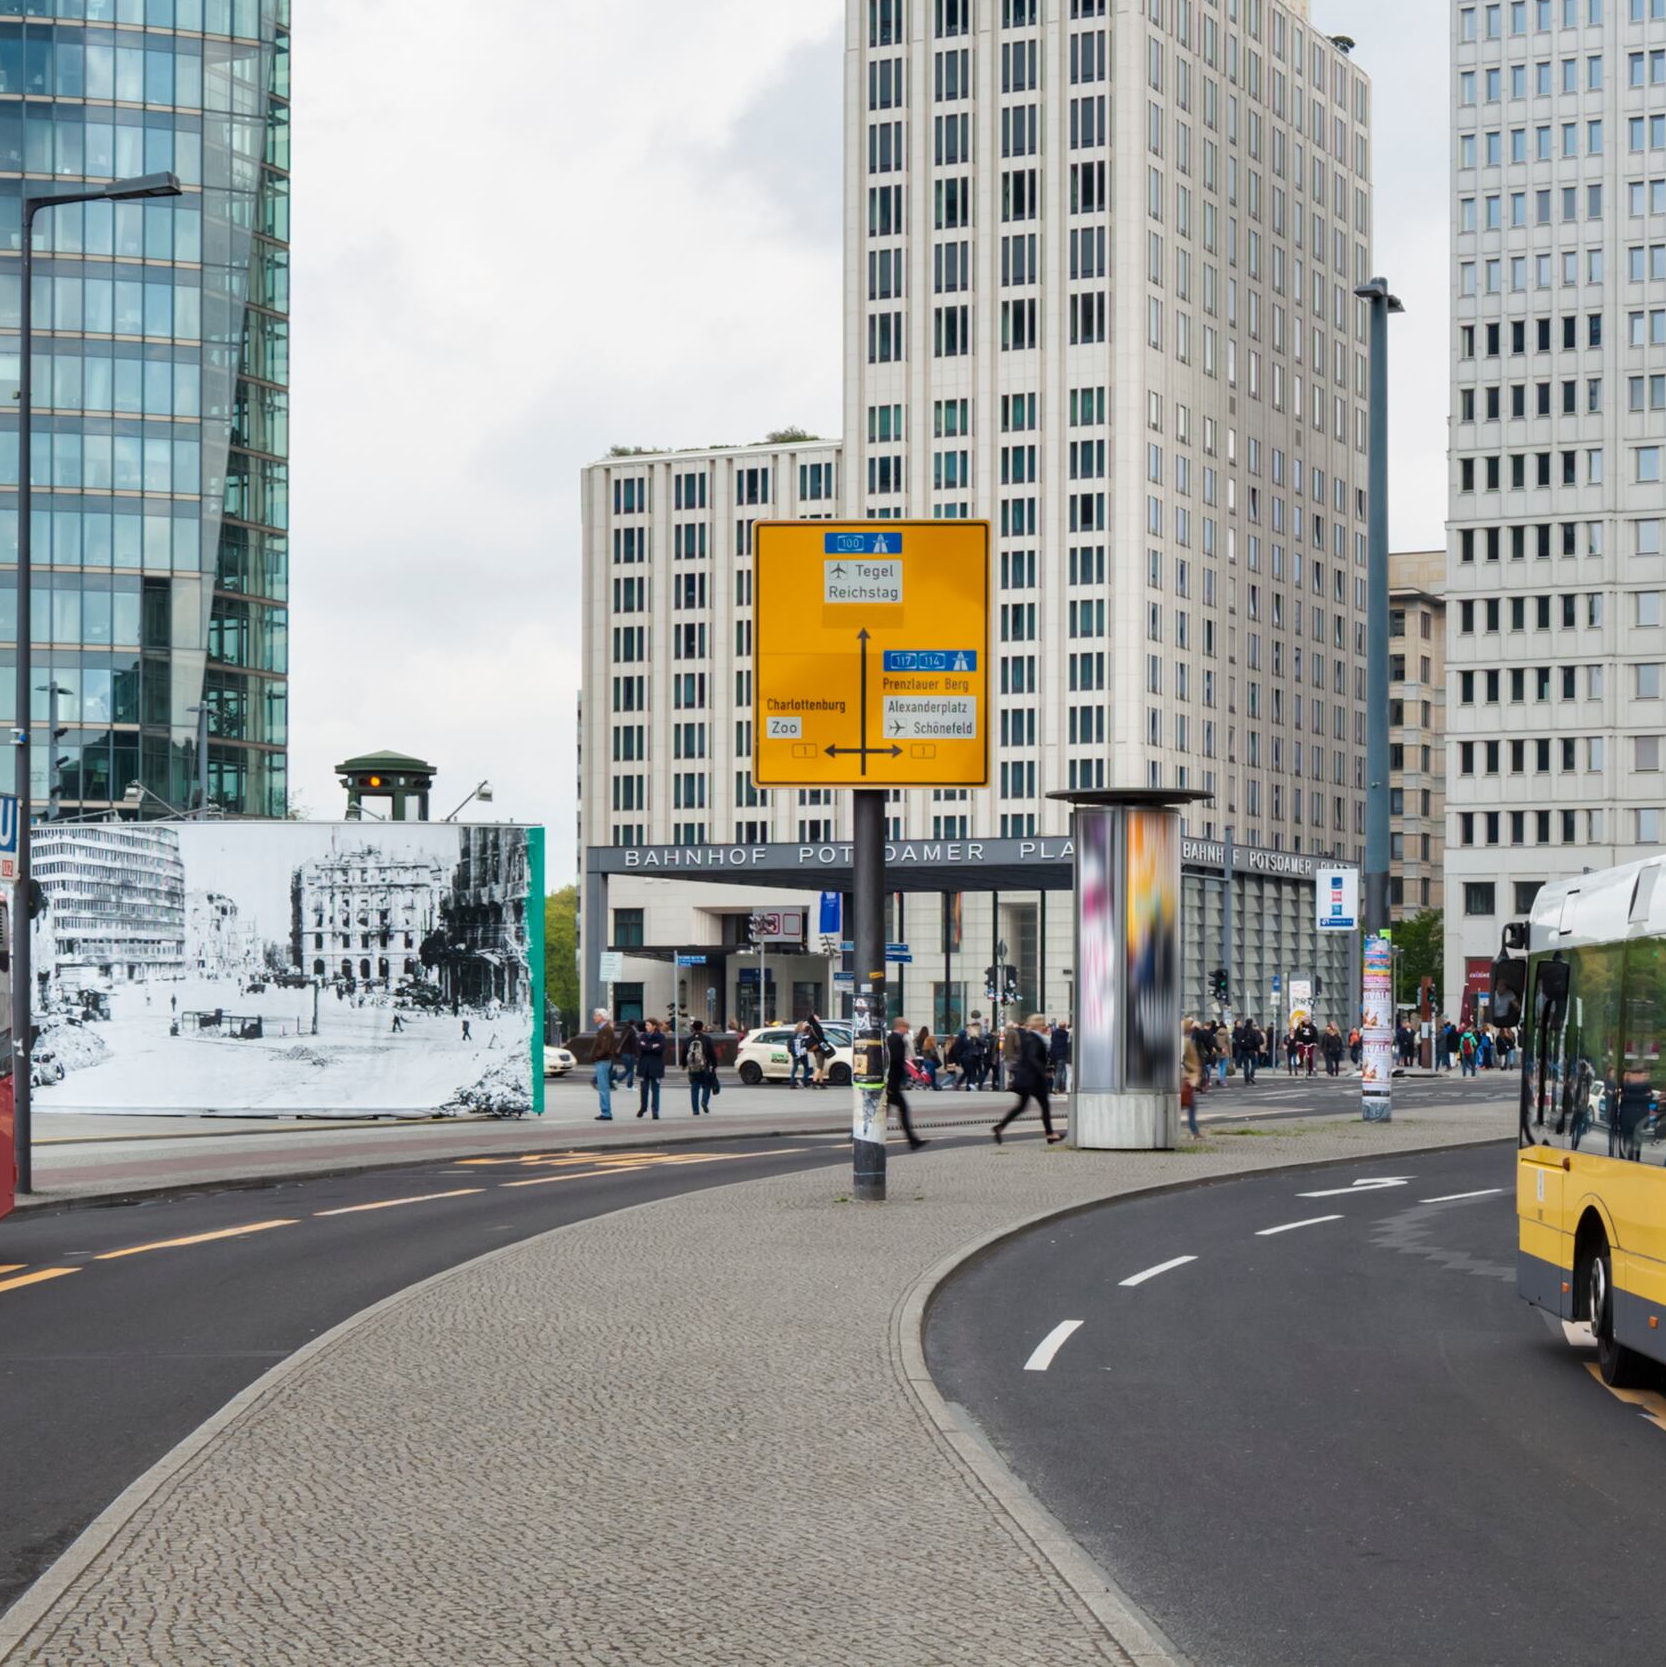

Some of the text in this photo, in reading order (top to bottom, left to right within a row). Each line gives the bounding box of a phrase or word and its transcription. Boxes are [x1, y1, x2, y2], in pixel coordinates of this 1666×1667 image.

[842, 538, 860, 548] 100
[855, 564, 894, 581] Tegel
[829, 585, 899, 602] Reichstag
[896, 656, 940, 666] 117 114
[883, 677, 969, 694] Prenzlauer Berg
[767, 697, 846, 714] Charlottenburg
[888, 700, 968, 717] Alexanderplatz
[772, 720, 798, 734] Zoo
[913, 721, 973, 735] Schönefeld
[624, 840, 1074, 868] BAHNHOF POTDAMER PLA
[1183, 837, 1312, 876] BAHNHF POTSDAMER
[3, 861, 13, 876] U2
